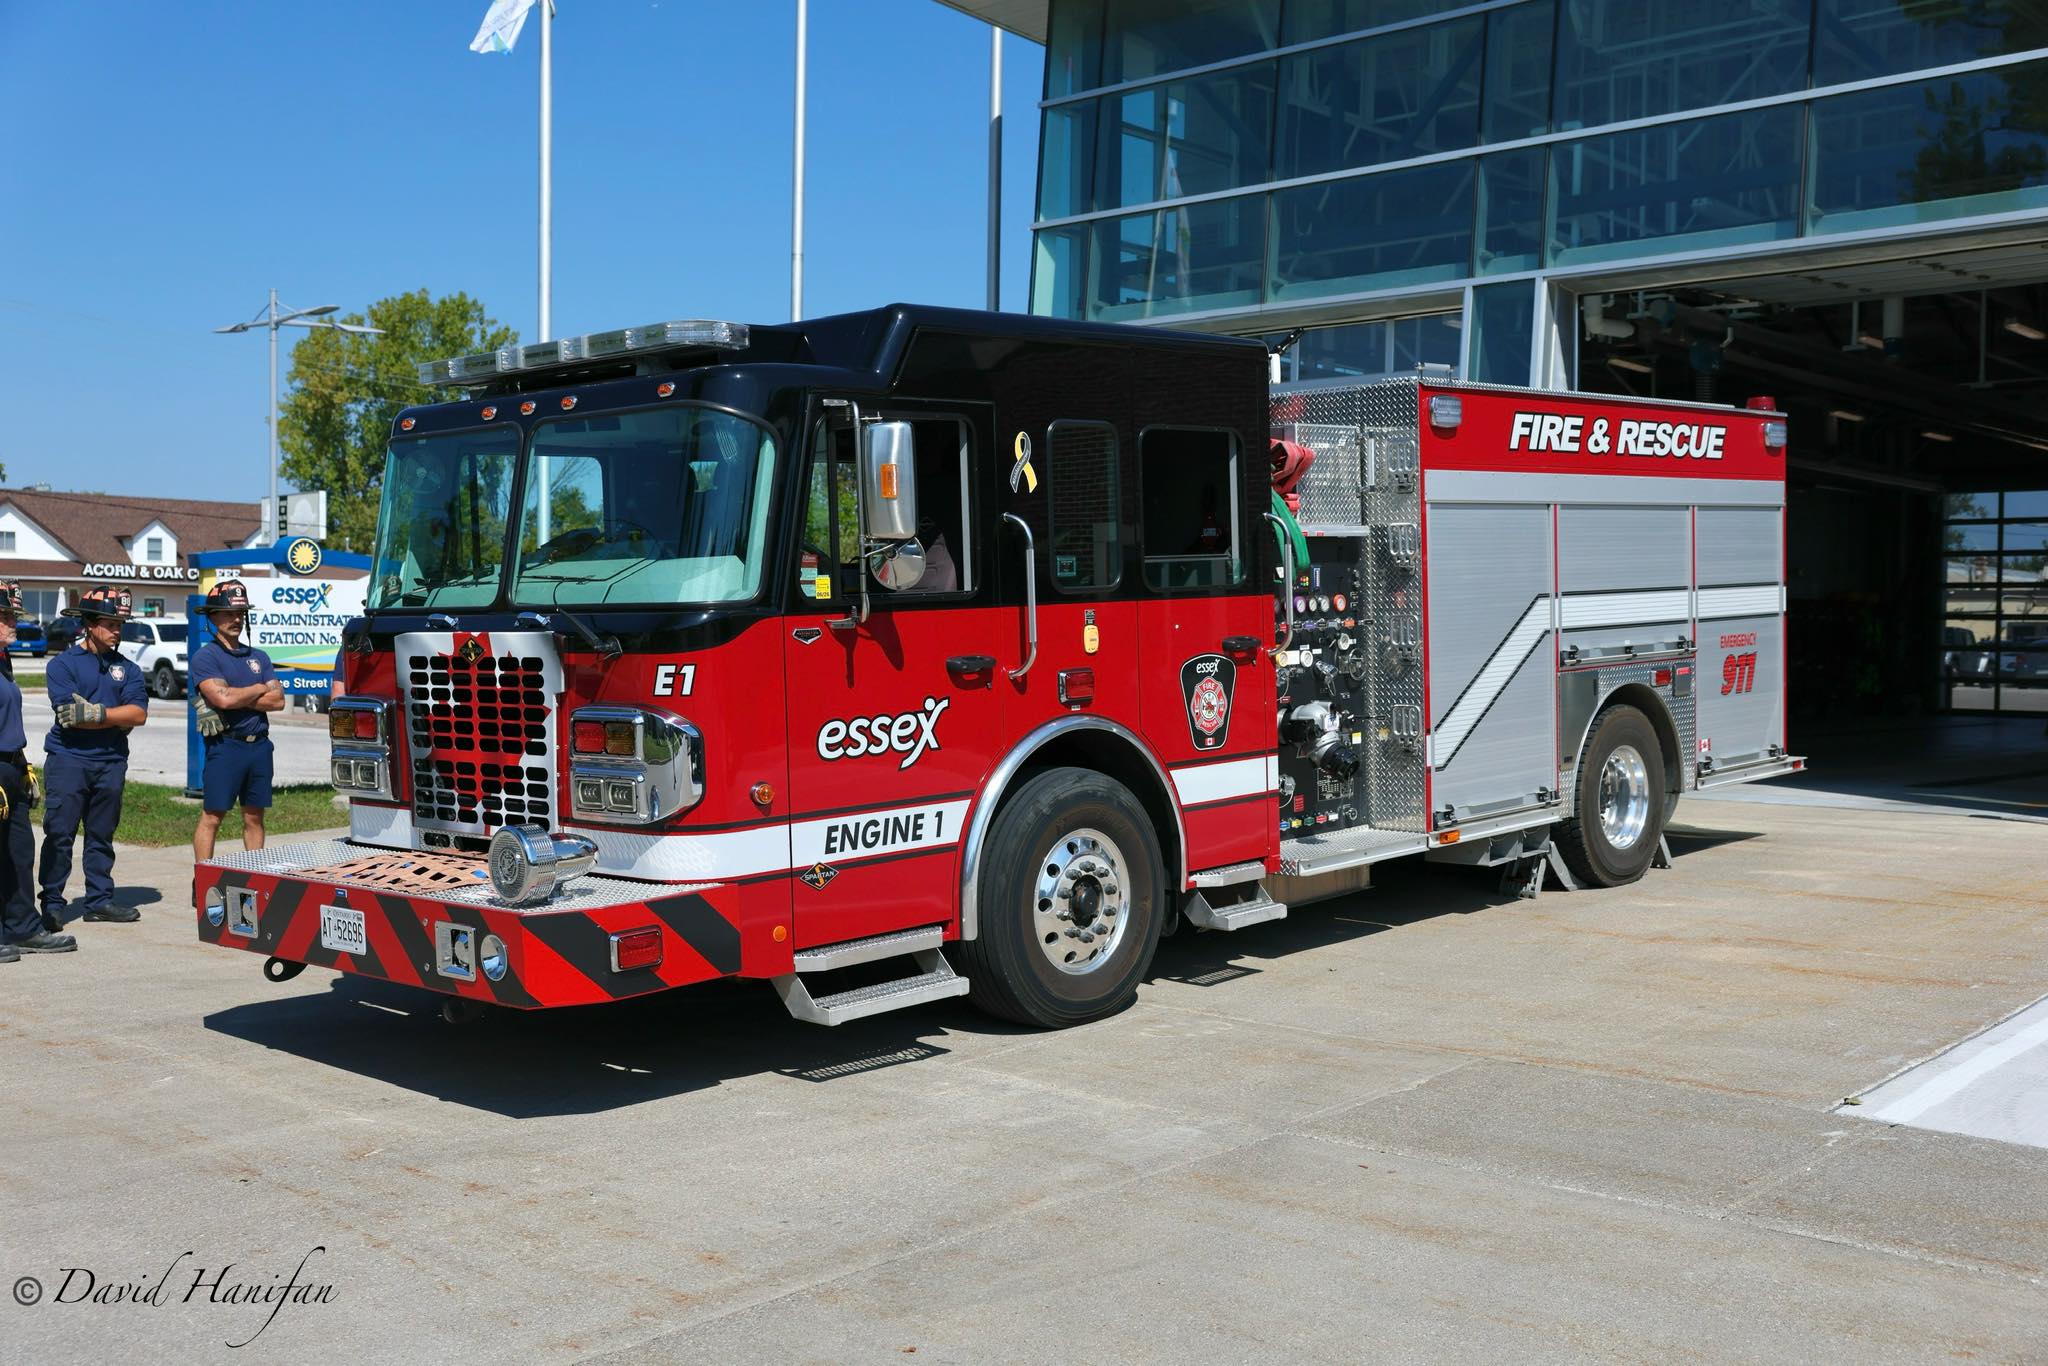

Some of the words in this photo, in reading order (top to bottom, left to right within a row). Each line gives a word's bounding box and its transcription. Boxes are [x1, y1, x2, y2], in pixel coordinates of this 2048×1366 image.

[1509, 412, 1584, 452] FIRE
[1586, 416, 1611, 455] &
[1616, 419, 1727, 460] RESCUE
[83, 563, 136, 578] ACORN
[139, 566, 150, 578] &
[153, 566, 184, 579] OAK
[235, 587, 242, 597] 9
[272, 583, 333, 613] essex
[260, 614, 363, 627] ADMINISTRAT
[259, 632, 316, 645] STATION
[1720, 632, 1757, 649] EMERGENCY
[1196, 659, 1220, 677] essex
[1720, 651, 1757, 696] 911
[293, 678, 328, 689] Street
[653, 663, 697, 698] E1
[1202, 682, 1215, 690] FIRE
[817, 696, 951, 771] essex
[824, 813, 925, 855] ENGINE
[934, 810, 944, 838] 1
[804, 870, 835, 881] SPARTAN
[322, 917, 332, 938] AT
[336, 919, 363, 944] 52696
